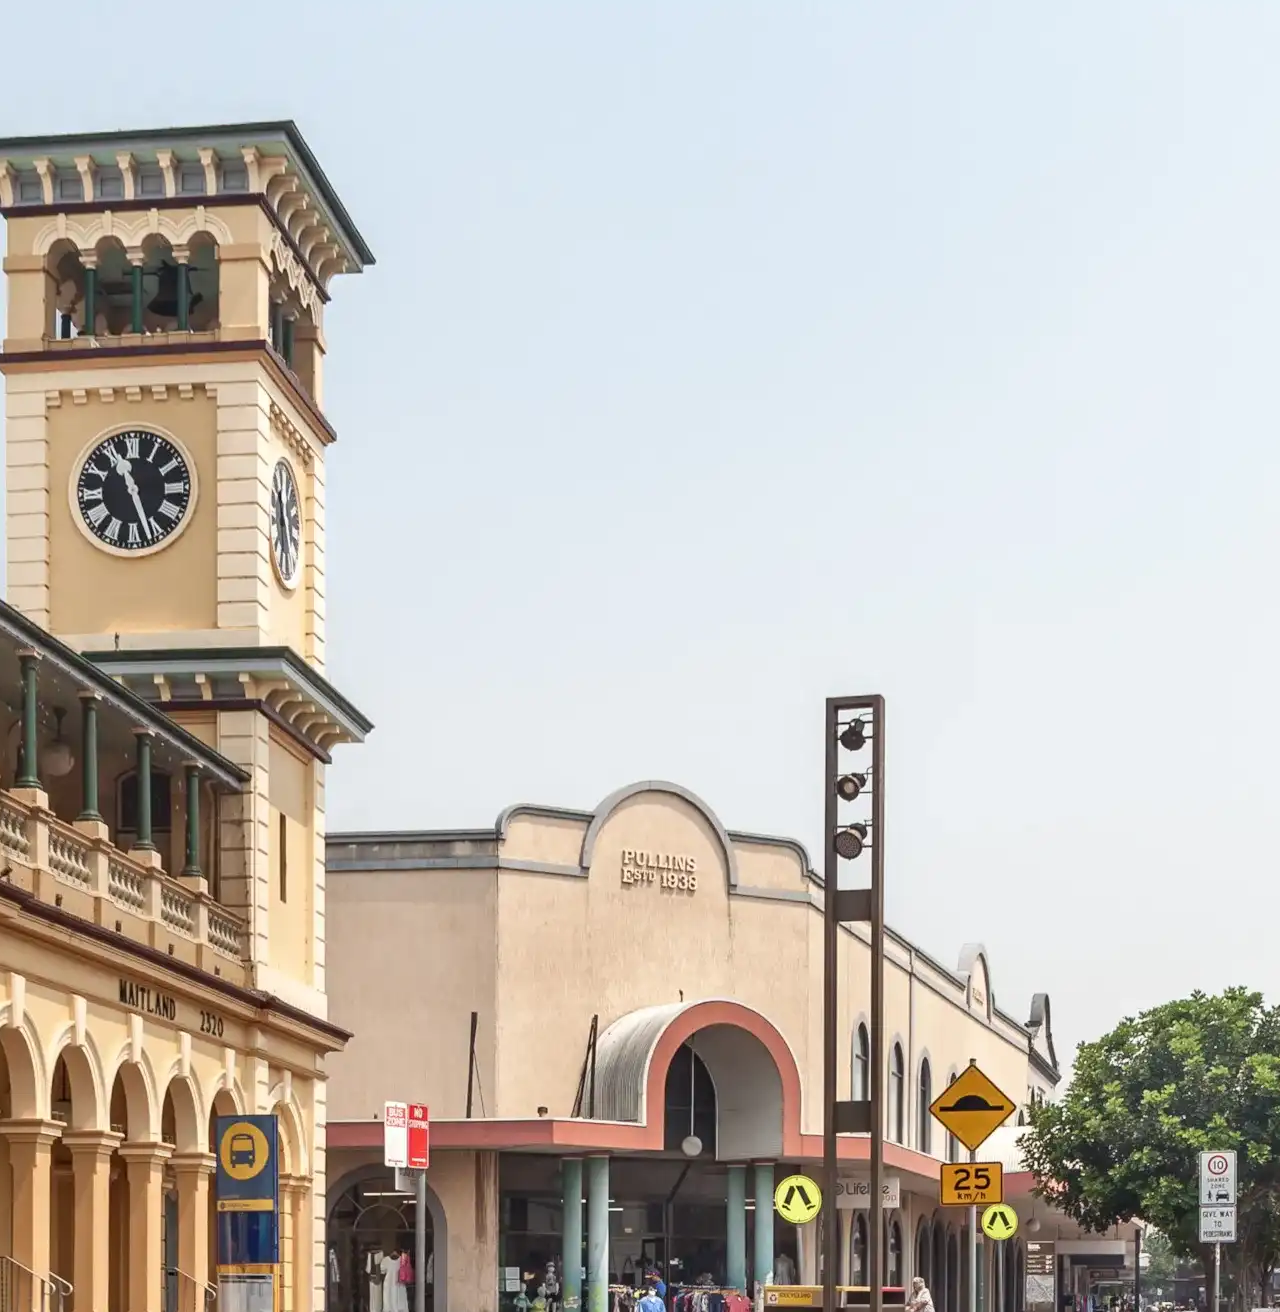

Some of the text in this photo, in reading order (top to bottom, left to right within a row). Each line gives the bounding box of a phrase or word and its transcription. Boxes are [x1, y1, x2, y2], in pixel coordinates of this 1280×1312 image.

[622, 850, 697, 873] PULLINS
[660, 871, 698, 891] 1938
[119, 979, 224, 1038] MAITLAND 2320
[387, 1107, 405, 1118] BUS
[413, 1107, 424, 1119] NO
[1213, 1160, 1224, 1170] 10
[953, 1168, 991, 1191] 25
[845, 1182, 889, 1196] Lifele
[957, 1191, 986, 1203] km/h
